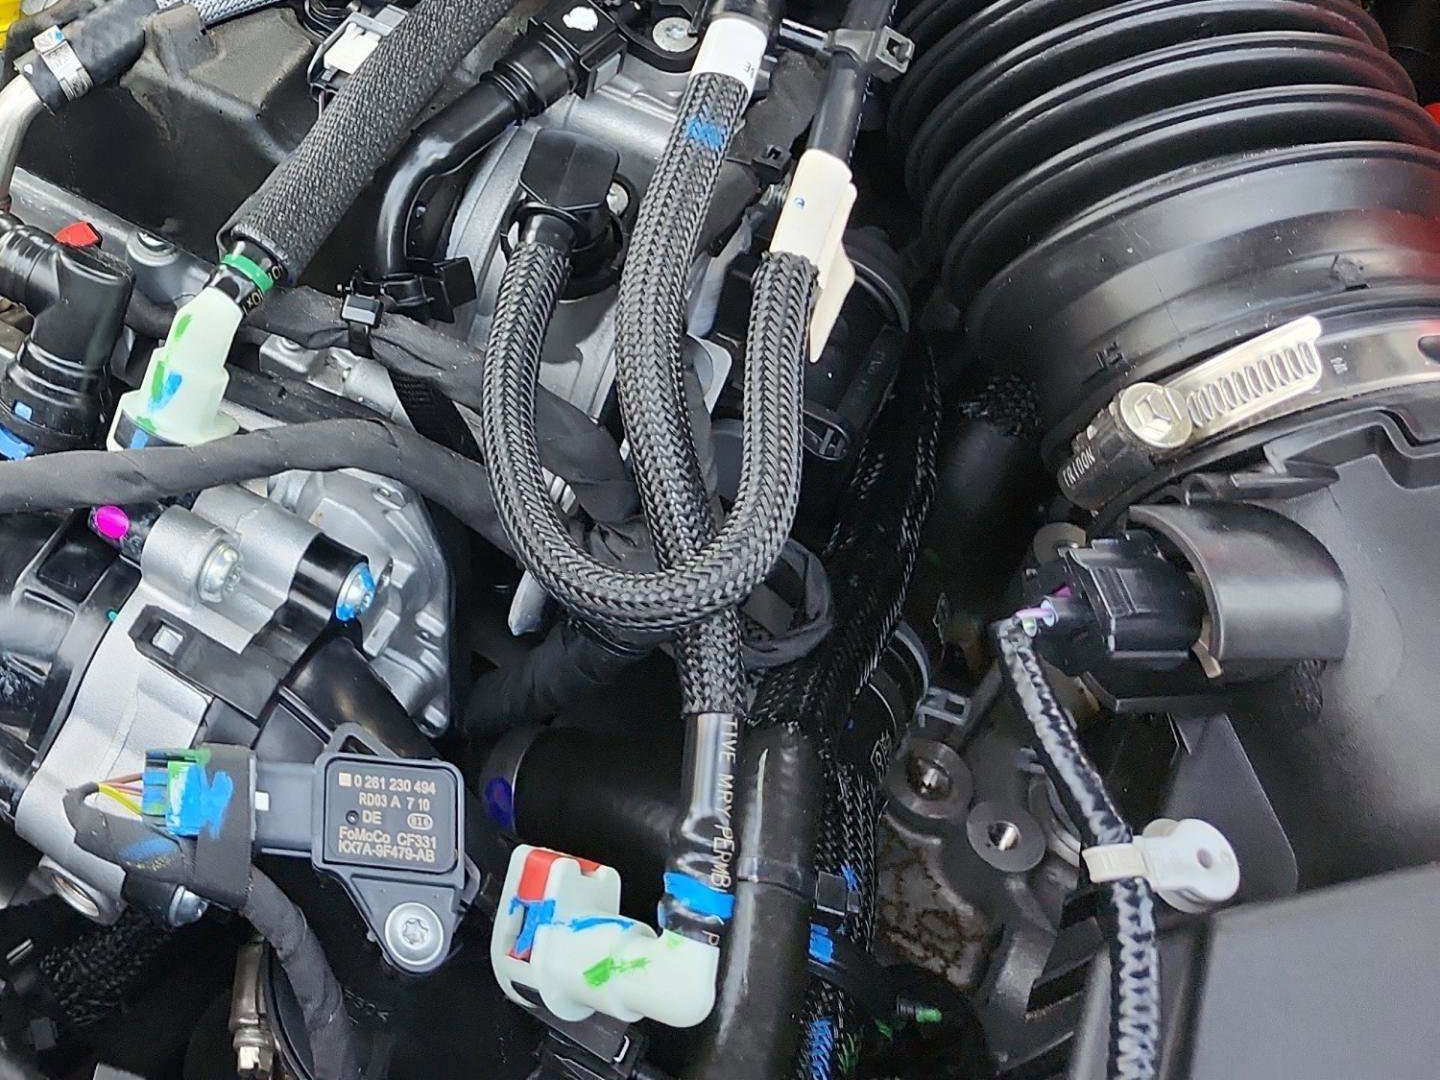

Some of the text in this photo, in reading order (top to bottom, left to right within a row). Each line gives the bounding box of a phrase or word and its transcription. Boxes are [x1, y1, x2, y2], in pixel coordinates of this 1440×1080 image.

[1062, 446, 1096, 488] TRIDON
[353, 774, 437, 795] 0 261 230 494
[390, 795, 401, 809] A
[406, 796, 415, 810] 7
[418, 798, 431, 812] 10
[715, 772, 735, 819] MRY
[362, 810, 383, 825] DE
[339, 826, 391, 844] FoMoCo
